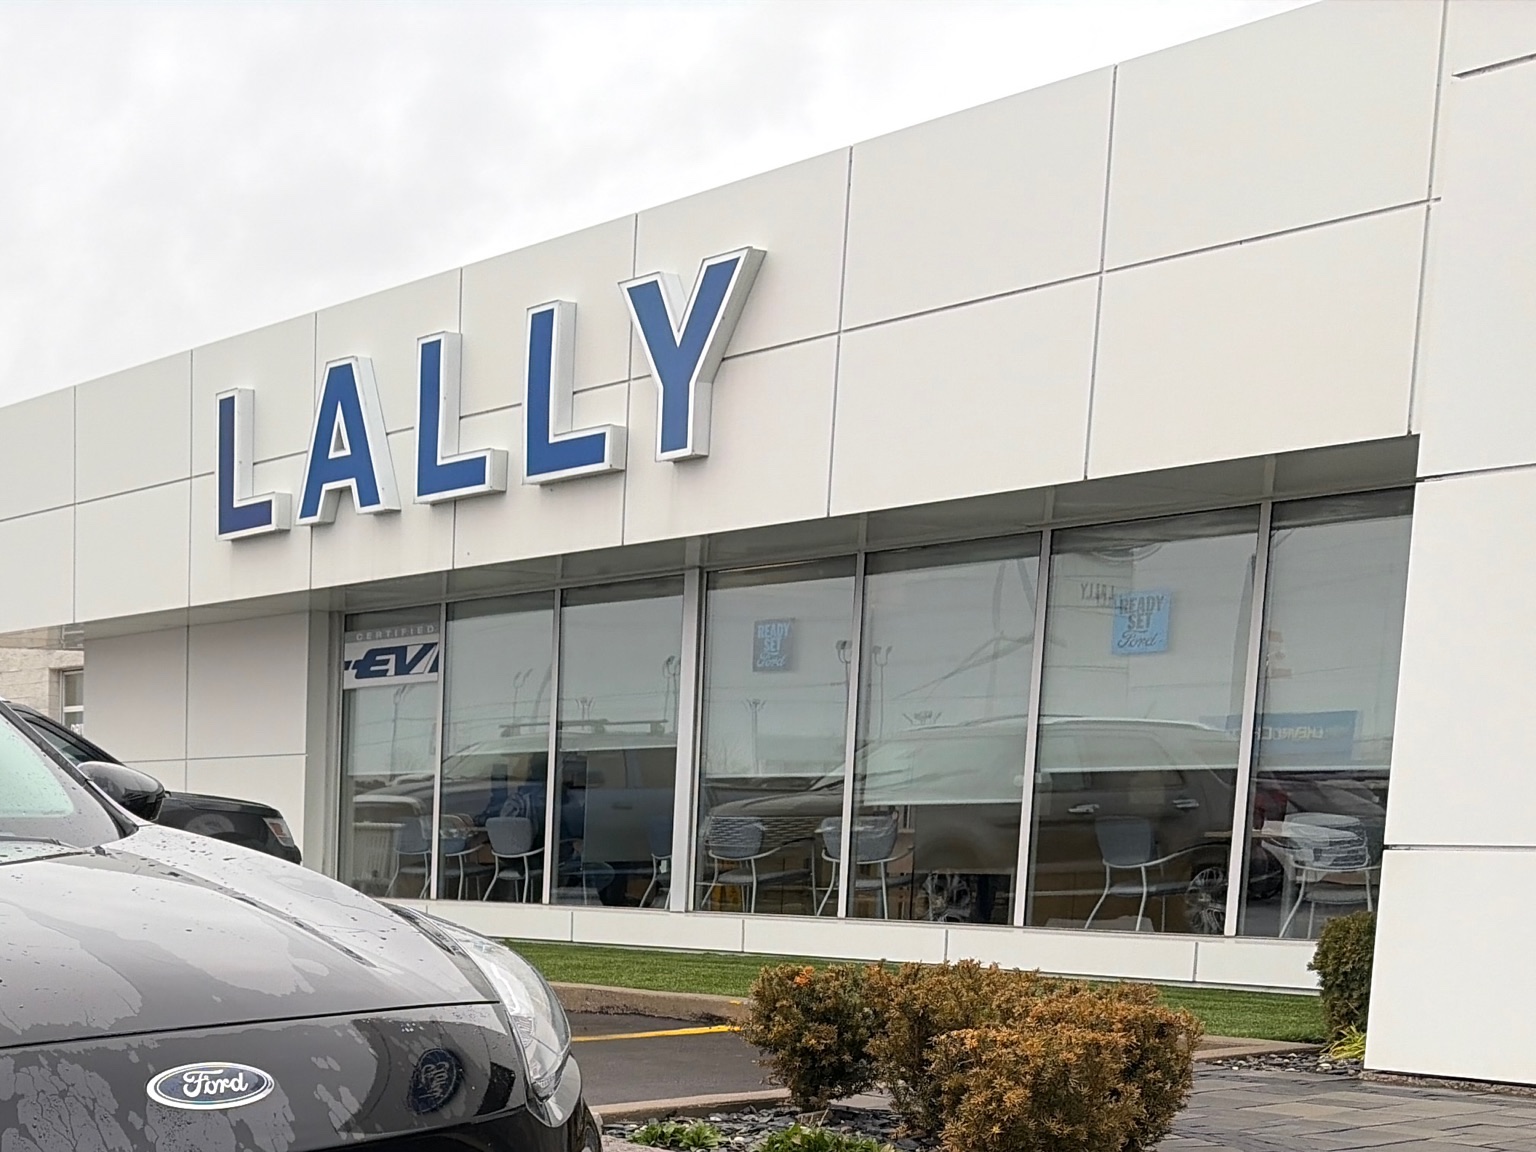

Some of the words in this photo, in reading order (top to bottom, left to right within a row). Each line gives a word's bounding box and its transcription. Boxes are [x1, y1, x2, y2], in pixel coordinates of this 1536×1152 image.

[215, 246, 767, 542] LALLY
[1119, 595, 1164, 615] READY
[1127, 612, 1152, 630] SET
[356, 624, 435, 641] CERTIFIED
[757, 623, 790, 639] READY
[1117, 631, 1158, 649] Ford
[764, 638, 781, 651] SET
[182, 1069, 249, 1098] Ford
